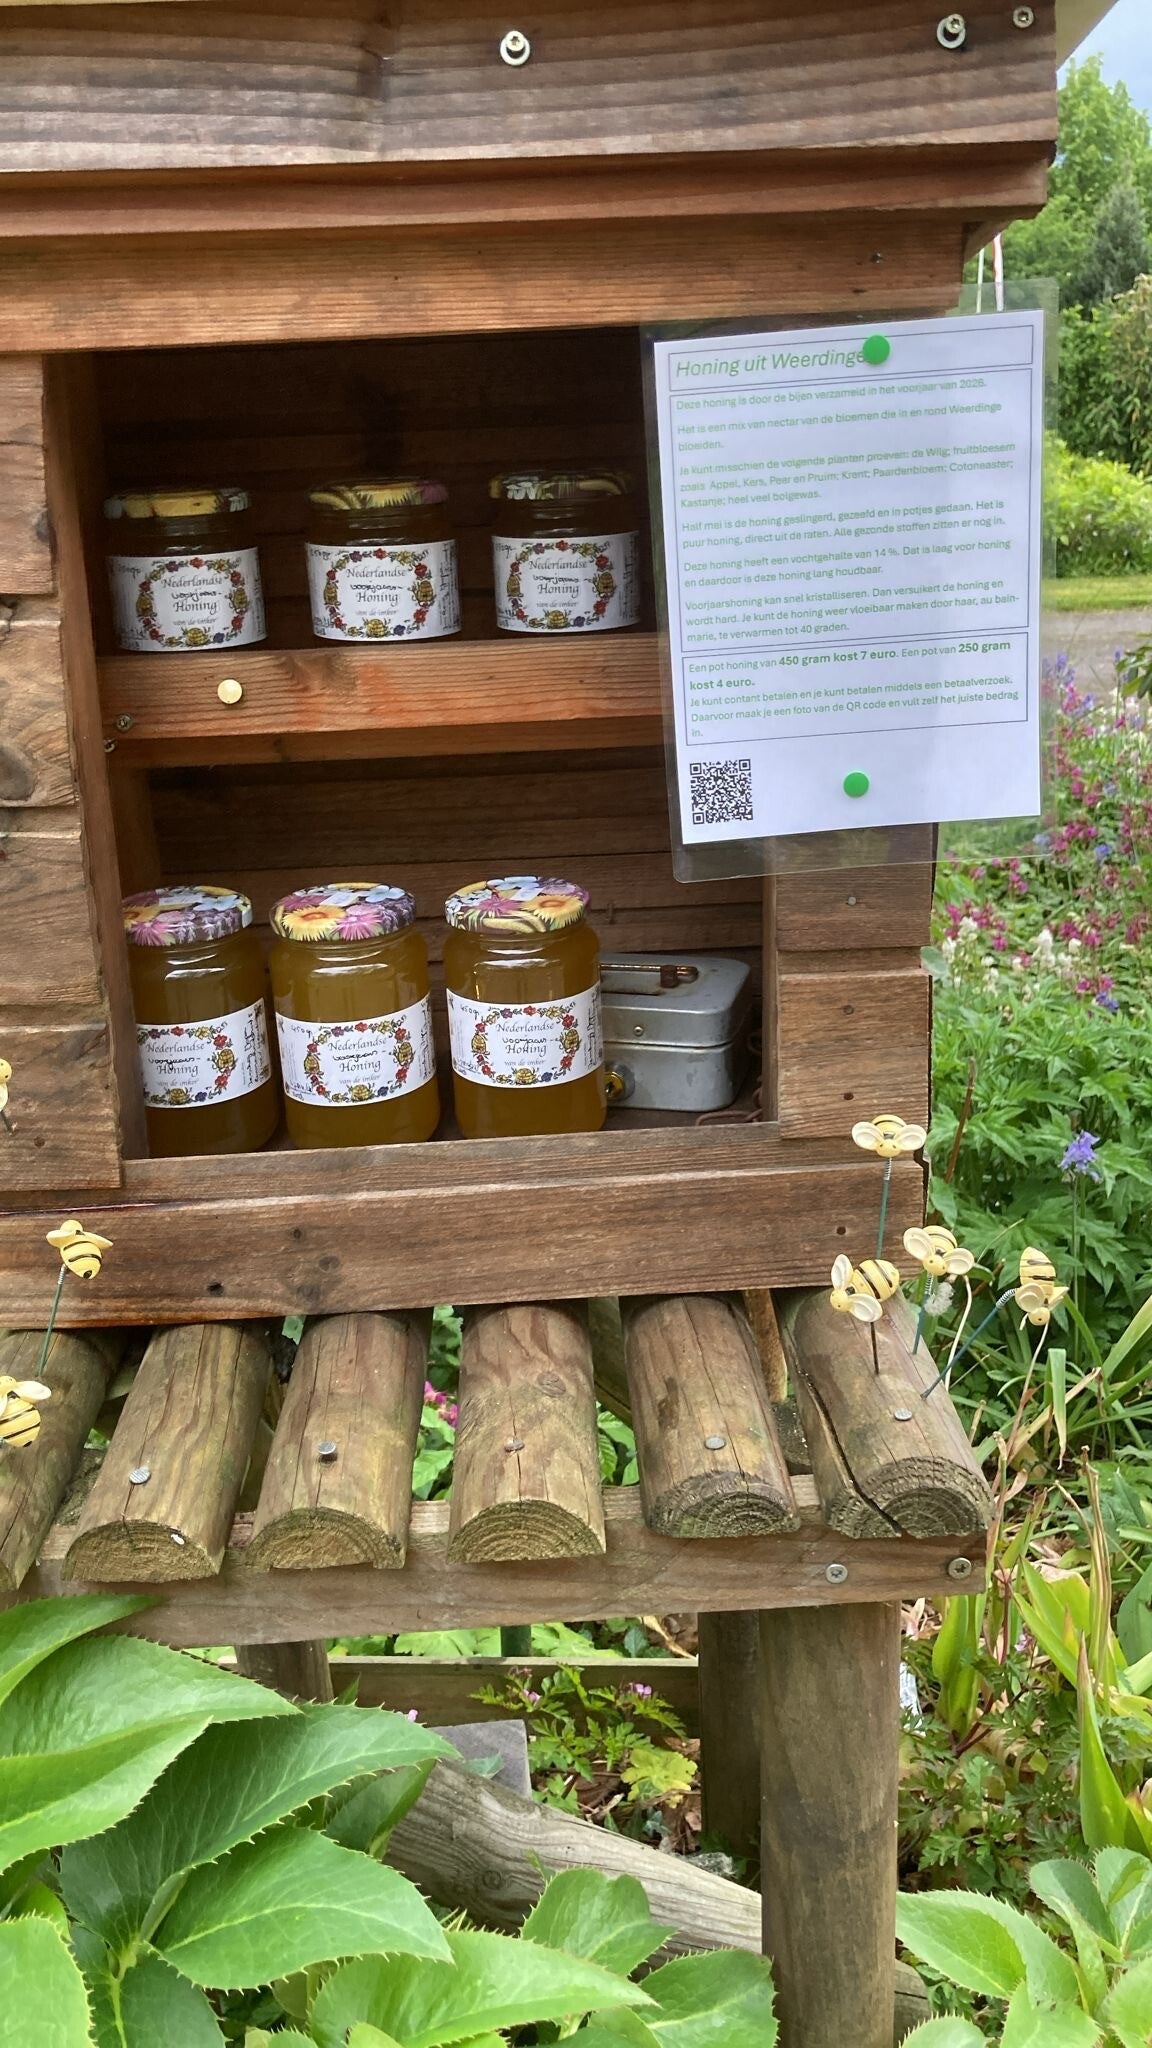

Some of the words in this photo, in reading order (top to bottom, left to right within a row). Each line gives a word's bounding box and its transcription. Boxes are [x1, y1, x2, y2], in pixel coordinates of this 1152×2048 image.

[676, 358, 741, 377] Honing
[744, 355, 767, 372] uit
[682, 539, 706, 549] puur
[706, 536, 743, 546] honing,
[744, 534, 773, 543] direct
[774, 532, 789, 541] uit
[833, 527, 852, 536] Alle
[853, 524, 895, 537] gezonde
[896, 522, 930, 532] stoffen
[932, 520, 960, 529] zitten
[973, 518, 993, 527] nog
[992, 515, 1006, 525] in.
[529, 557, 587, 570] Nederlandse
[683, 562, 707, 572] Deze
[709, 560, 742, 570] honing
[743, 557, 769, 566] heeft
[770, 557, 789, 565] een
[790, 551, 853, 563] vochtgehalte
[854, 551, 872, 559] van
[874, 548, 886, 557] 14
[902, 546, 920, 555] Dat
[932, 544, 953, 554] laag
[953, 543, 976, 551] voor
[977, 540, 1011, 550] honing
[347, 565, 405, 578] Nederlandse
[697, 576, 742, 586] daardoor
[753, 573, 777, 582] deze
[778, 570, 812, 581] honing
[811, 569, 834, 579] lang
[835, 566, 883, 576] houdbaar.
[161, 575, 222, 588] Nederlandse
[537, 583, 579, 598] Honing
[685, 598, 763, 610] Voorjaarshoning
[763, 596, 782, 605] kan
[783, 593, 804, 604] snel
[805, 590, 871, 601] kristalliseren.
[872, 588, 892, 597] Dan
[893, 584, 941, 595] versuikert
[956, 580, 990, 590] honing
[356, 592, 398, 607] Honing
[173, 602, 217, 615] Honing
[685, 616, 714, 626] wordt
[752, 612, 775, 621] kunt
[790, 608, 823, 619] honing
[824, 607, 848, 616] weer
[849, 604, 895, 614] vloeibaar
[895, 601, 929, 610] maken
[929, 599, 954, 608] door
[954, 597, 979, 606] haar,
[994, 594, 1019, 604] bain-
[686, 632, 717, 642] marie,
[729, 628, 783, 638] verwarmen
[783, 626, 799, 635] tot
[800, 624, 813, 633] 40
[813, 623, 849, 634] graden.
[688, 663, 707, 673] Een
[708, 662, 724, 672] pot
[726, 660, 758, 670] honing
[759, 659, 777, 667] van
[778, 655, 799, 666] 450
[801, 655, 831, 666] gram
[833, 652, 858, 662] kost
[860, 650, 868, 660] 7
[869, 650, 899, 659] euro.
[901, 648, 920, 657] Een
[921, 647, 938, 657] pot
[938, 646, 956, 654] van
[958, 642, 979, 653] 250
[981, 642, 1011, 653] gram
[689, 680, 714, 690] kost
[716, 679, 724, 688] 4
[725, 678, 755, 687] euro.
[701, 696, 722, 705] kunt
[724, 694, 761, 704] contant
[762, 691, 799, 702] betalen
[823, 688, 845, 696] kunt
[846, 685, 882, 695] betalen
[884, 682, 922, 692] middels
[924, 681, 942, 689] een
[944, 675, 1013, 688] betaalverzoek.
[691, 712, 734, 722] Daarvoor
[735, 708, 762, 718] maak
[773, 708, 791, 716] een
[792, 705, 812, 714] foto
[846, 701, 861, 712] QR
[862, 700, 886, 709] code
[901, 697, 920, 706] vult
[921, 695, 938, 705] zelf
[940, 695, 956, 704] het
[957, 693, 985, 704] juiste
[985, 691, 1019, 700] bedrag
[496, 1020, 555, 1032] Nederlandse
[146, 1041, 205, 1053] Nederlandse
[328, 1036, 387, 1051] Nederlandse
[505, 1044, 547, 1057] Honing
[157, 1065, 199, 1078] Honing
[339, 1060, 381, 1073] Honing
